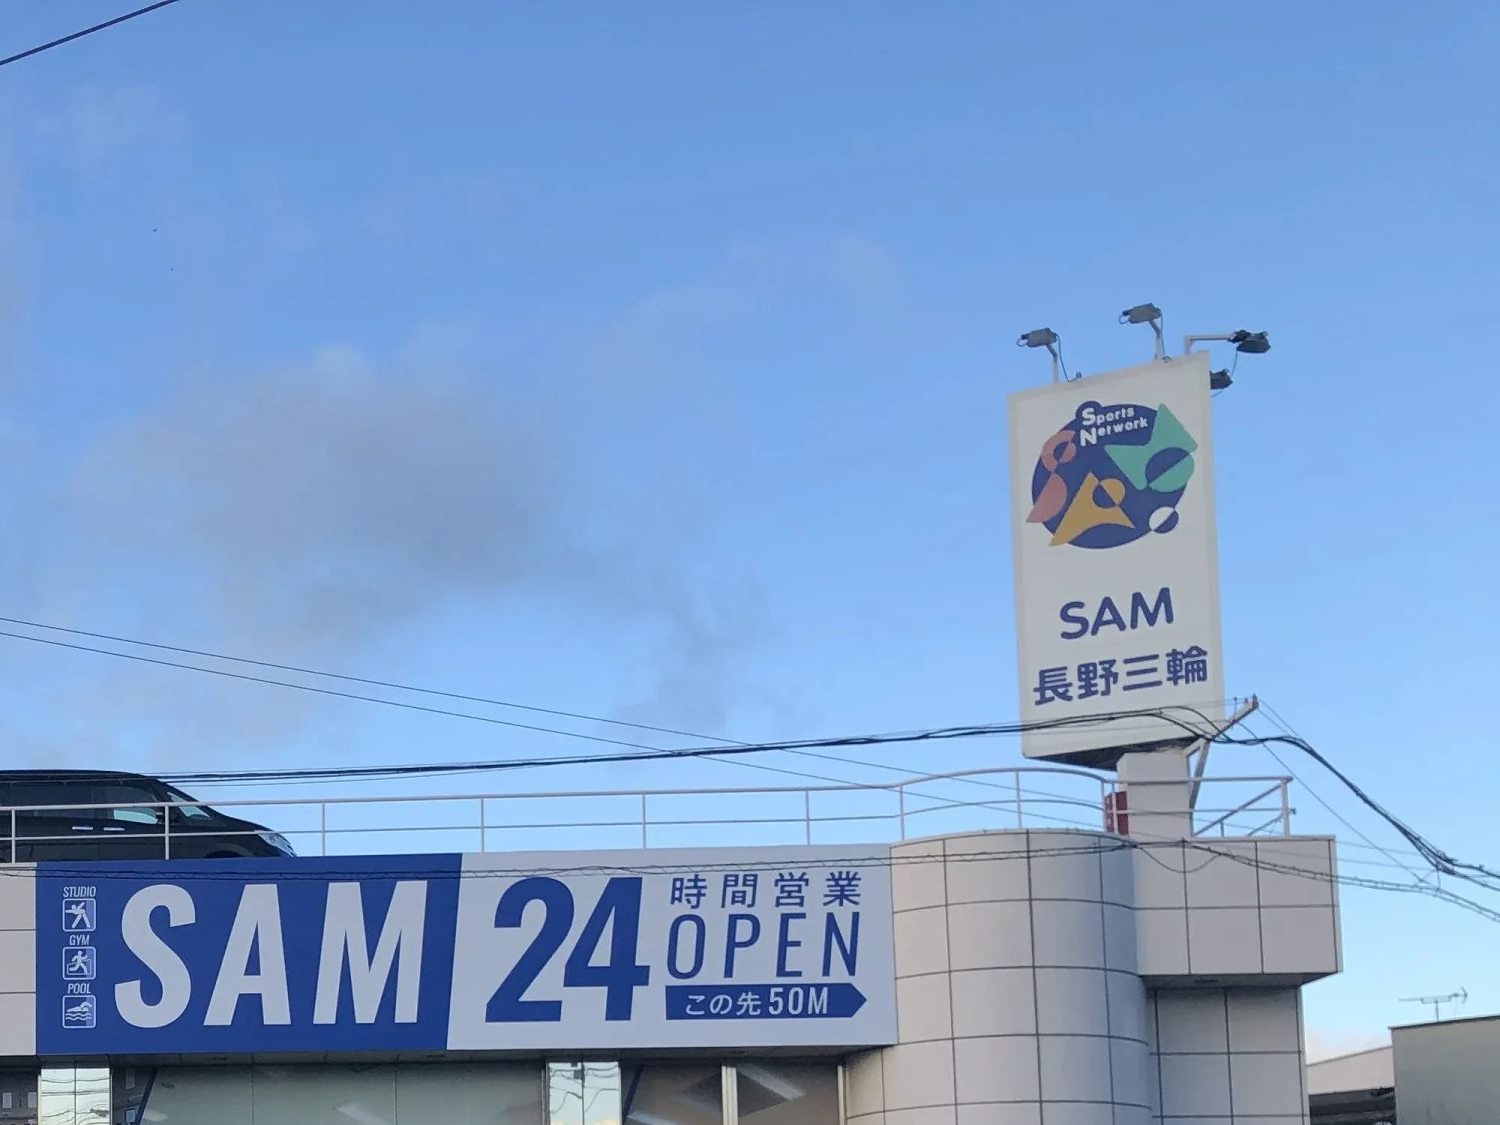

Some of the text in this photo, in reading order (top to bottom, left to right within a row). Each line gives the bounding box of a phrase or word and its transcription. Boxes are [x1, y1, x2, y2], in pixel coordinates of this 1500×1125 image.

[1080, 416, 1148, 447] Network
[1081, 407, 1135, 426] Sports
[1060, 587, 1174, 640] SAM
[1033, 645, 1208, 706] 長野三輪
[62, 886, 97, 898] STUDIO
[670, 870, 862, 909] 時間営業
[69, 934, 90, 946] GYM
[115, 880, 428, 1029] SAM
[485, 876, 650, 1023] 24
[667, 911, 860, 980] OPEN
[67, 983, 92, 994] POOL
